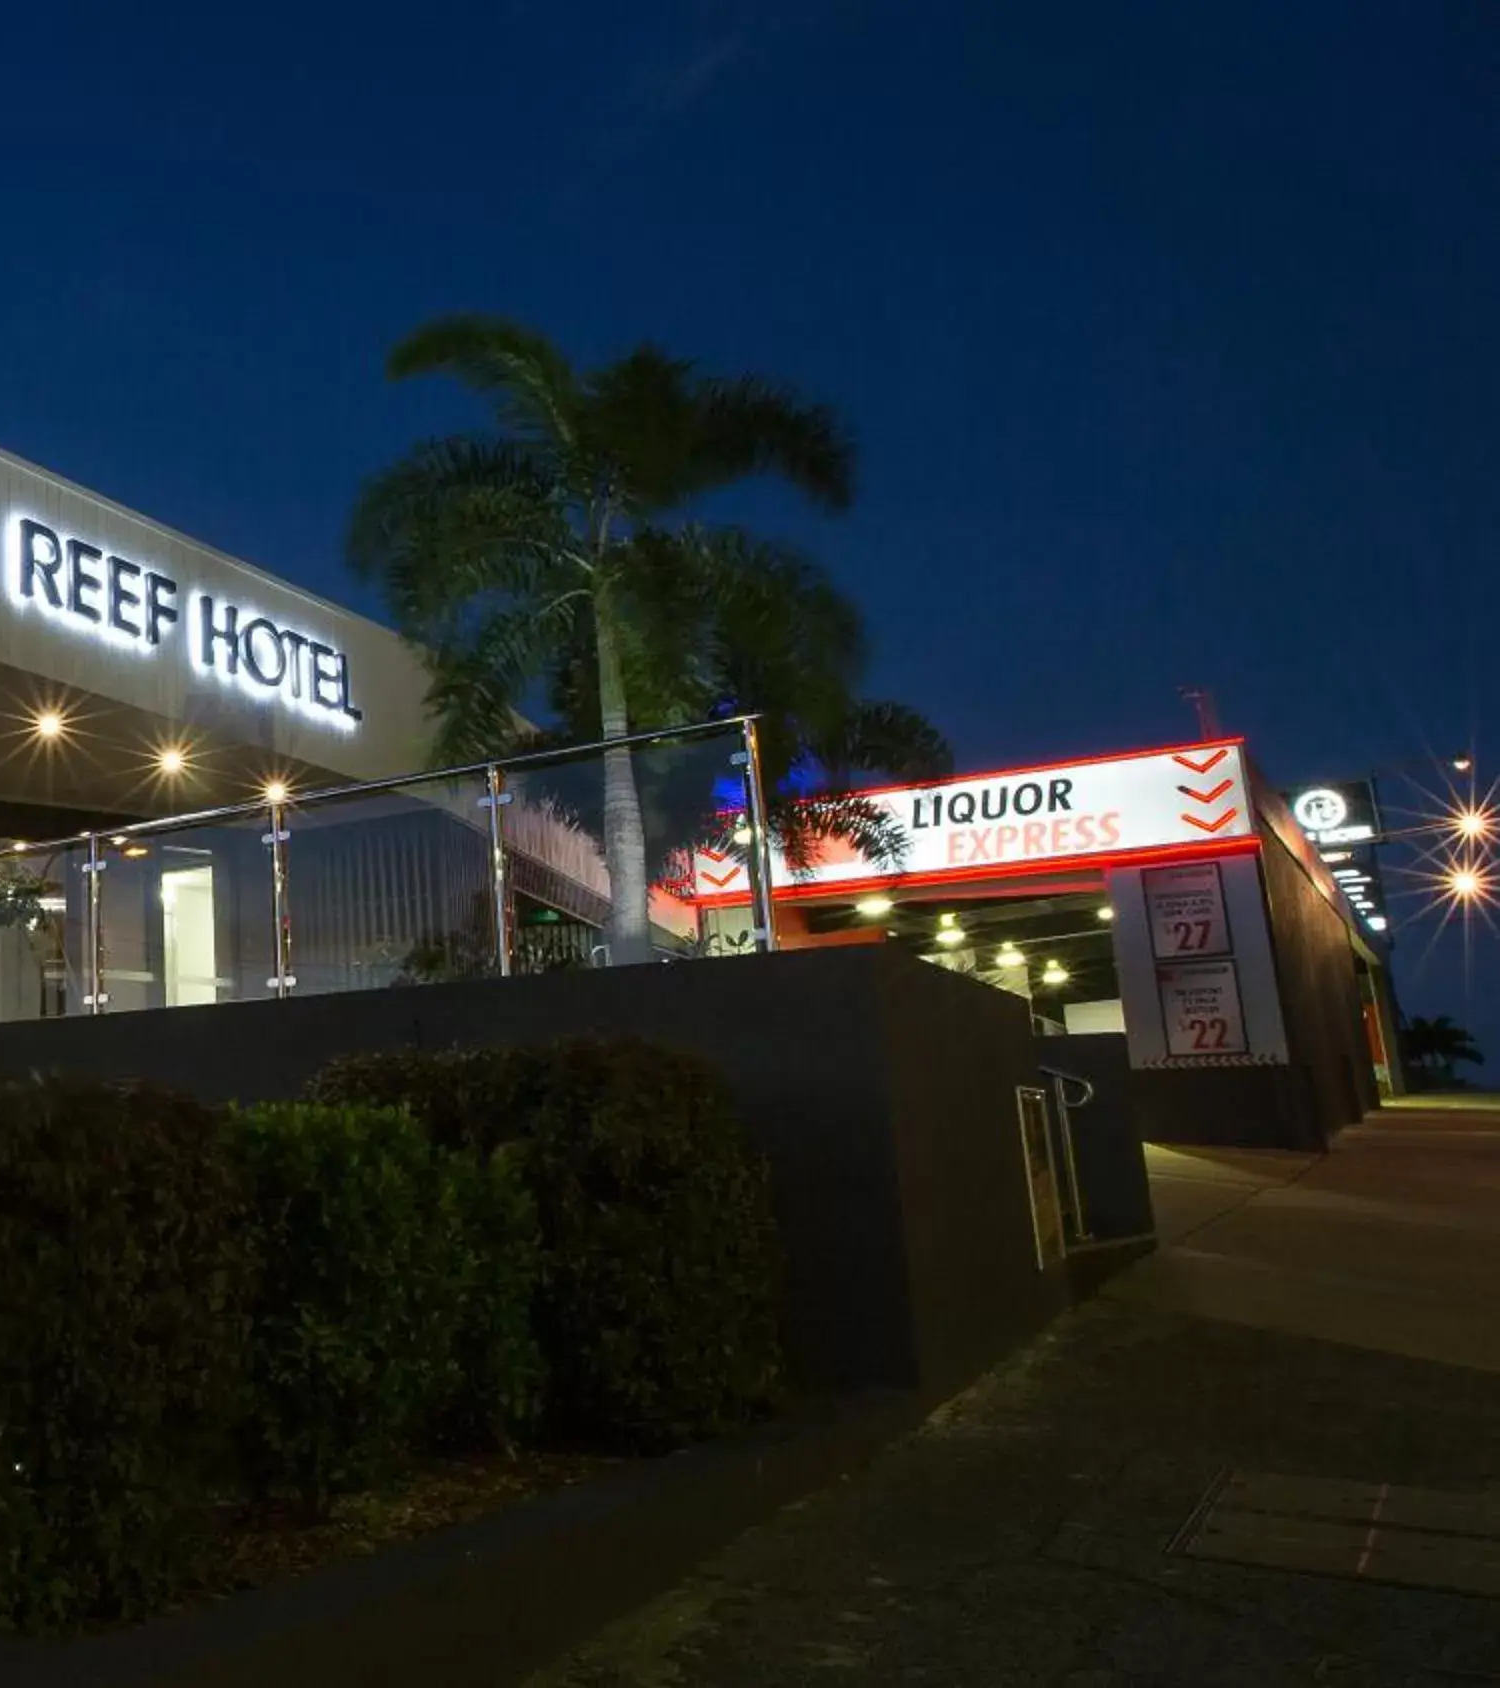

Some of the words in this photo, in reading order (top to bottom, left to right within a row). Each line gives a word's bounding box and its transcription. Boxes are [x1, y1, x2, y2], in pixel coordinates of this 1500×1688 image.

[19, 518, 178, 644] REEF
[200, 595, 362, 721] HOTEL
[912, 778, 1073, 829] LIQUOR
[947, 811, 1121, 865] EXPRESS
